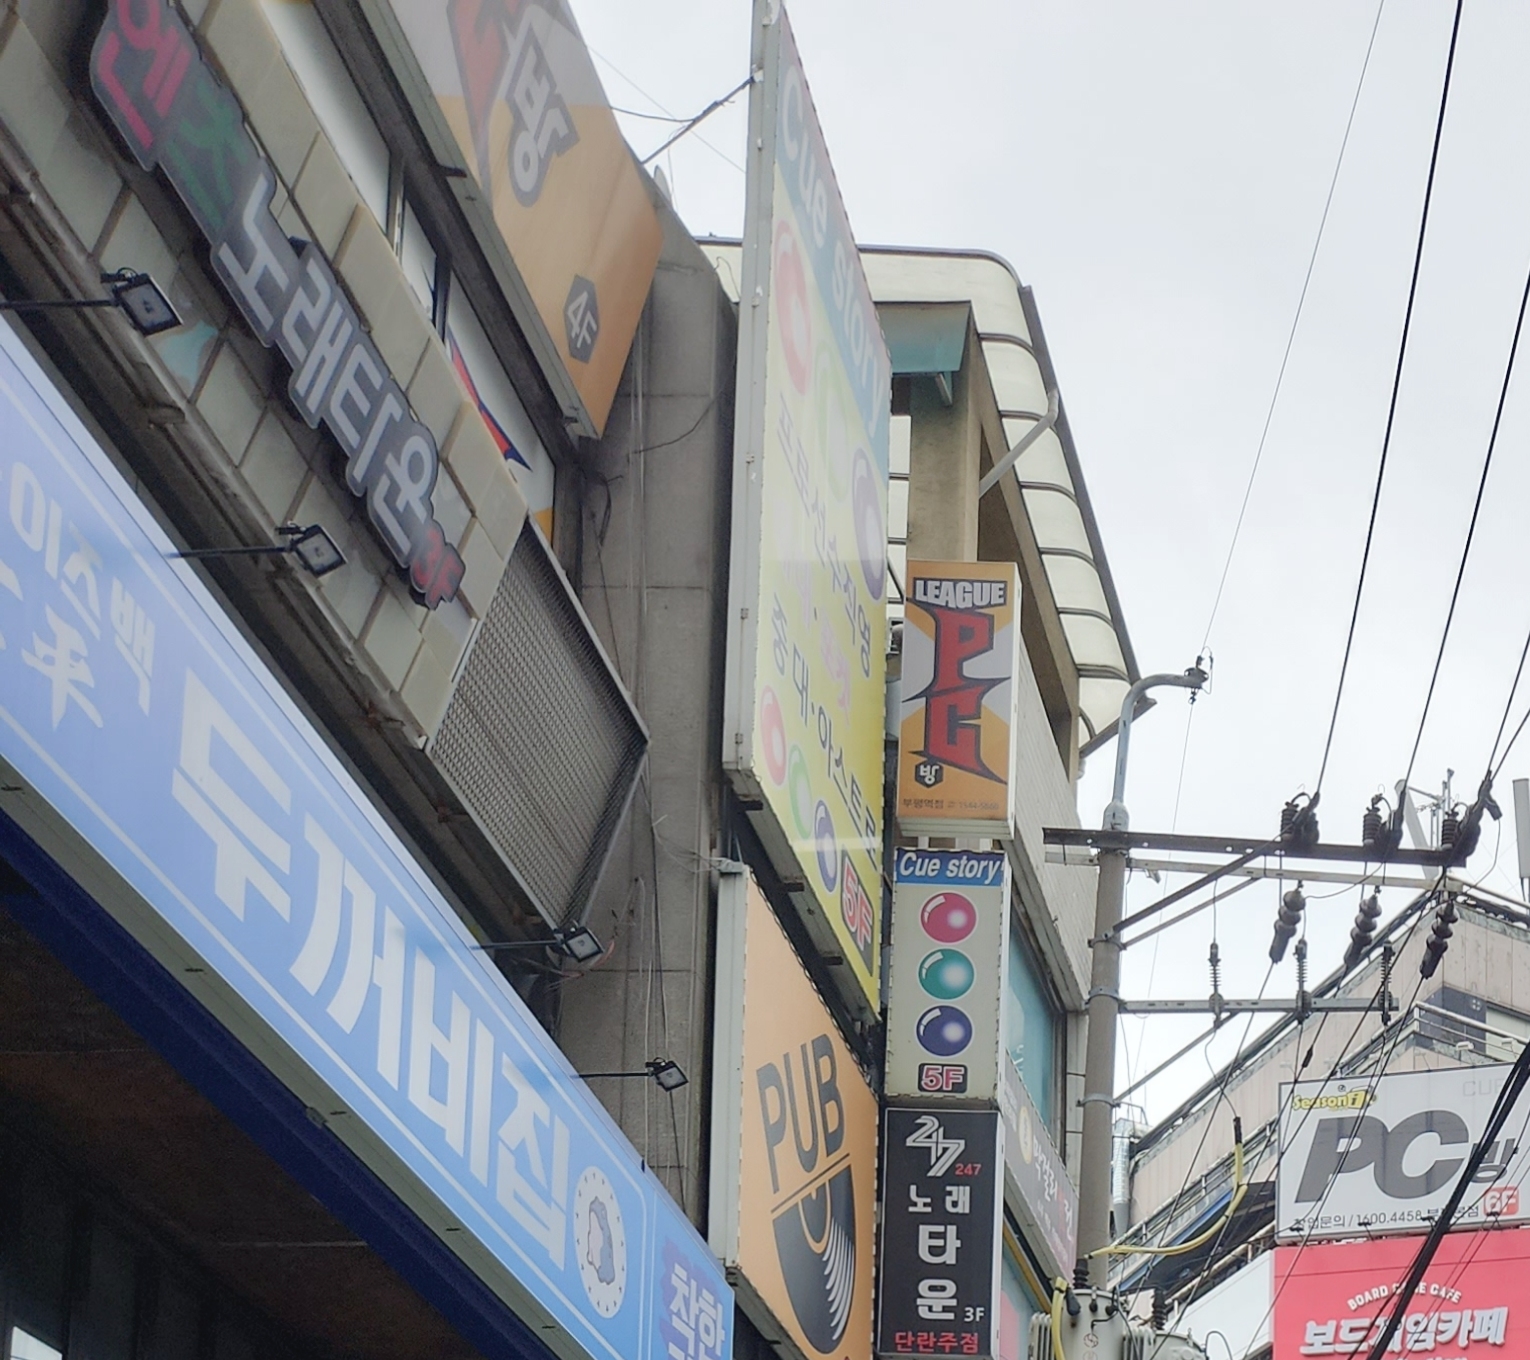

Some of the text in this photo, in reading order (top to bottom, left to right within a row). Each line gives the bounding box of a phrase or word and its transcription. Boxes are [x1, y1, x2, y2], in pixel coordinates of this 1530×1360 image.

[566, 289, 599, 351] 4F
[914, 579, 1007, 608] LEAGUE
[917, 761, 941, 787] 방
[899, 851, 1002, 885] Cue story
[842, 865, 873, 957] 5F
[171, 664, 569, 1273] 두꺼비집
[922, 1065, 965, 1092] 5F
[756, 1033, 846, 1194] PUB
[955, 1161, 982, 1177] 247
[1293, 1108, 1470, 1204] PC
[1356, 1208, 1422, 1226] 1600.4458
[907, 1184, 971, 1322] 노래타운
[670, 1261, 726, 1353] 착한
[1346, 1282, 1463, 1312] BOARD CAFE
[963, 1306, 986, 1323] 3F
[895, 1330, 980, 1354] 단란주점
